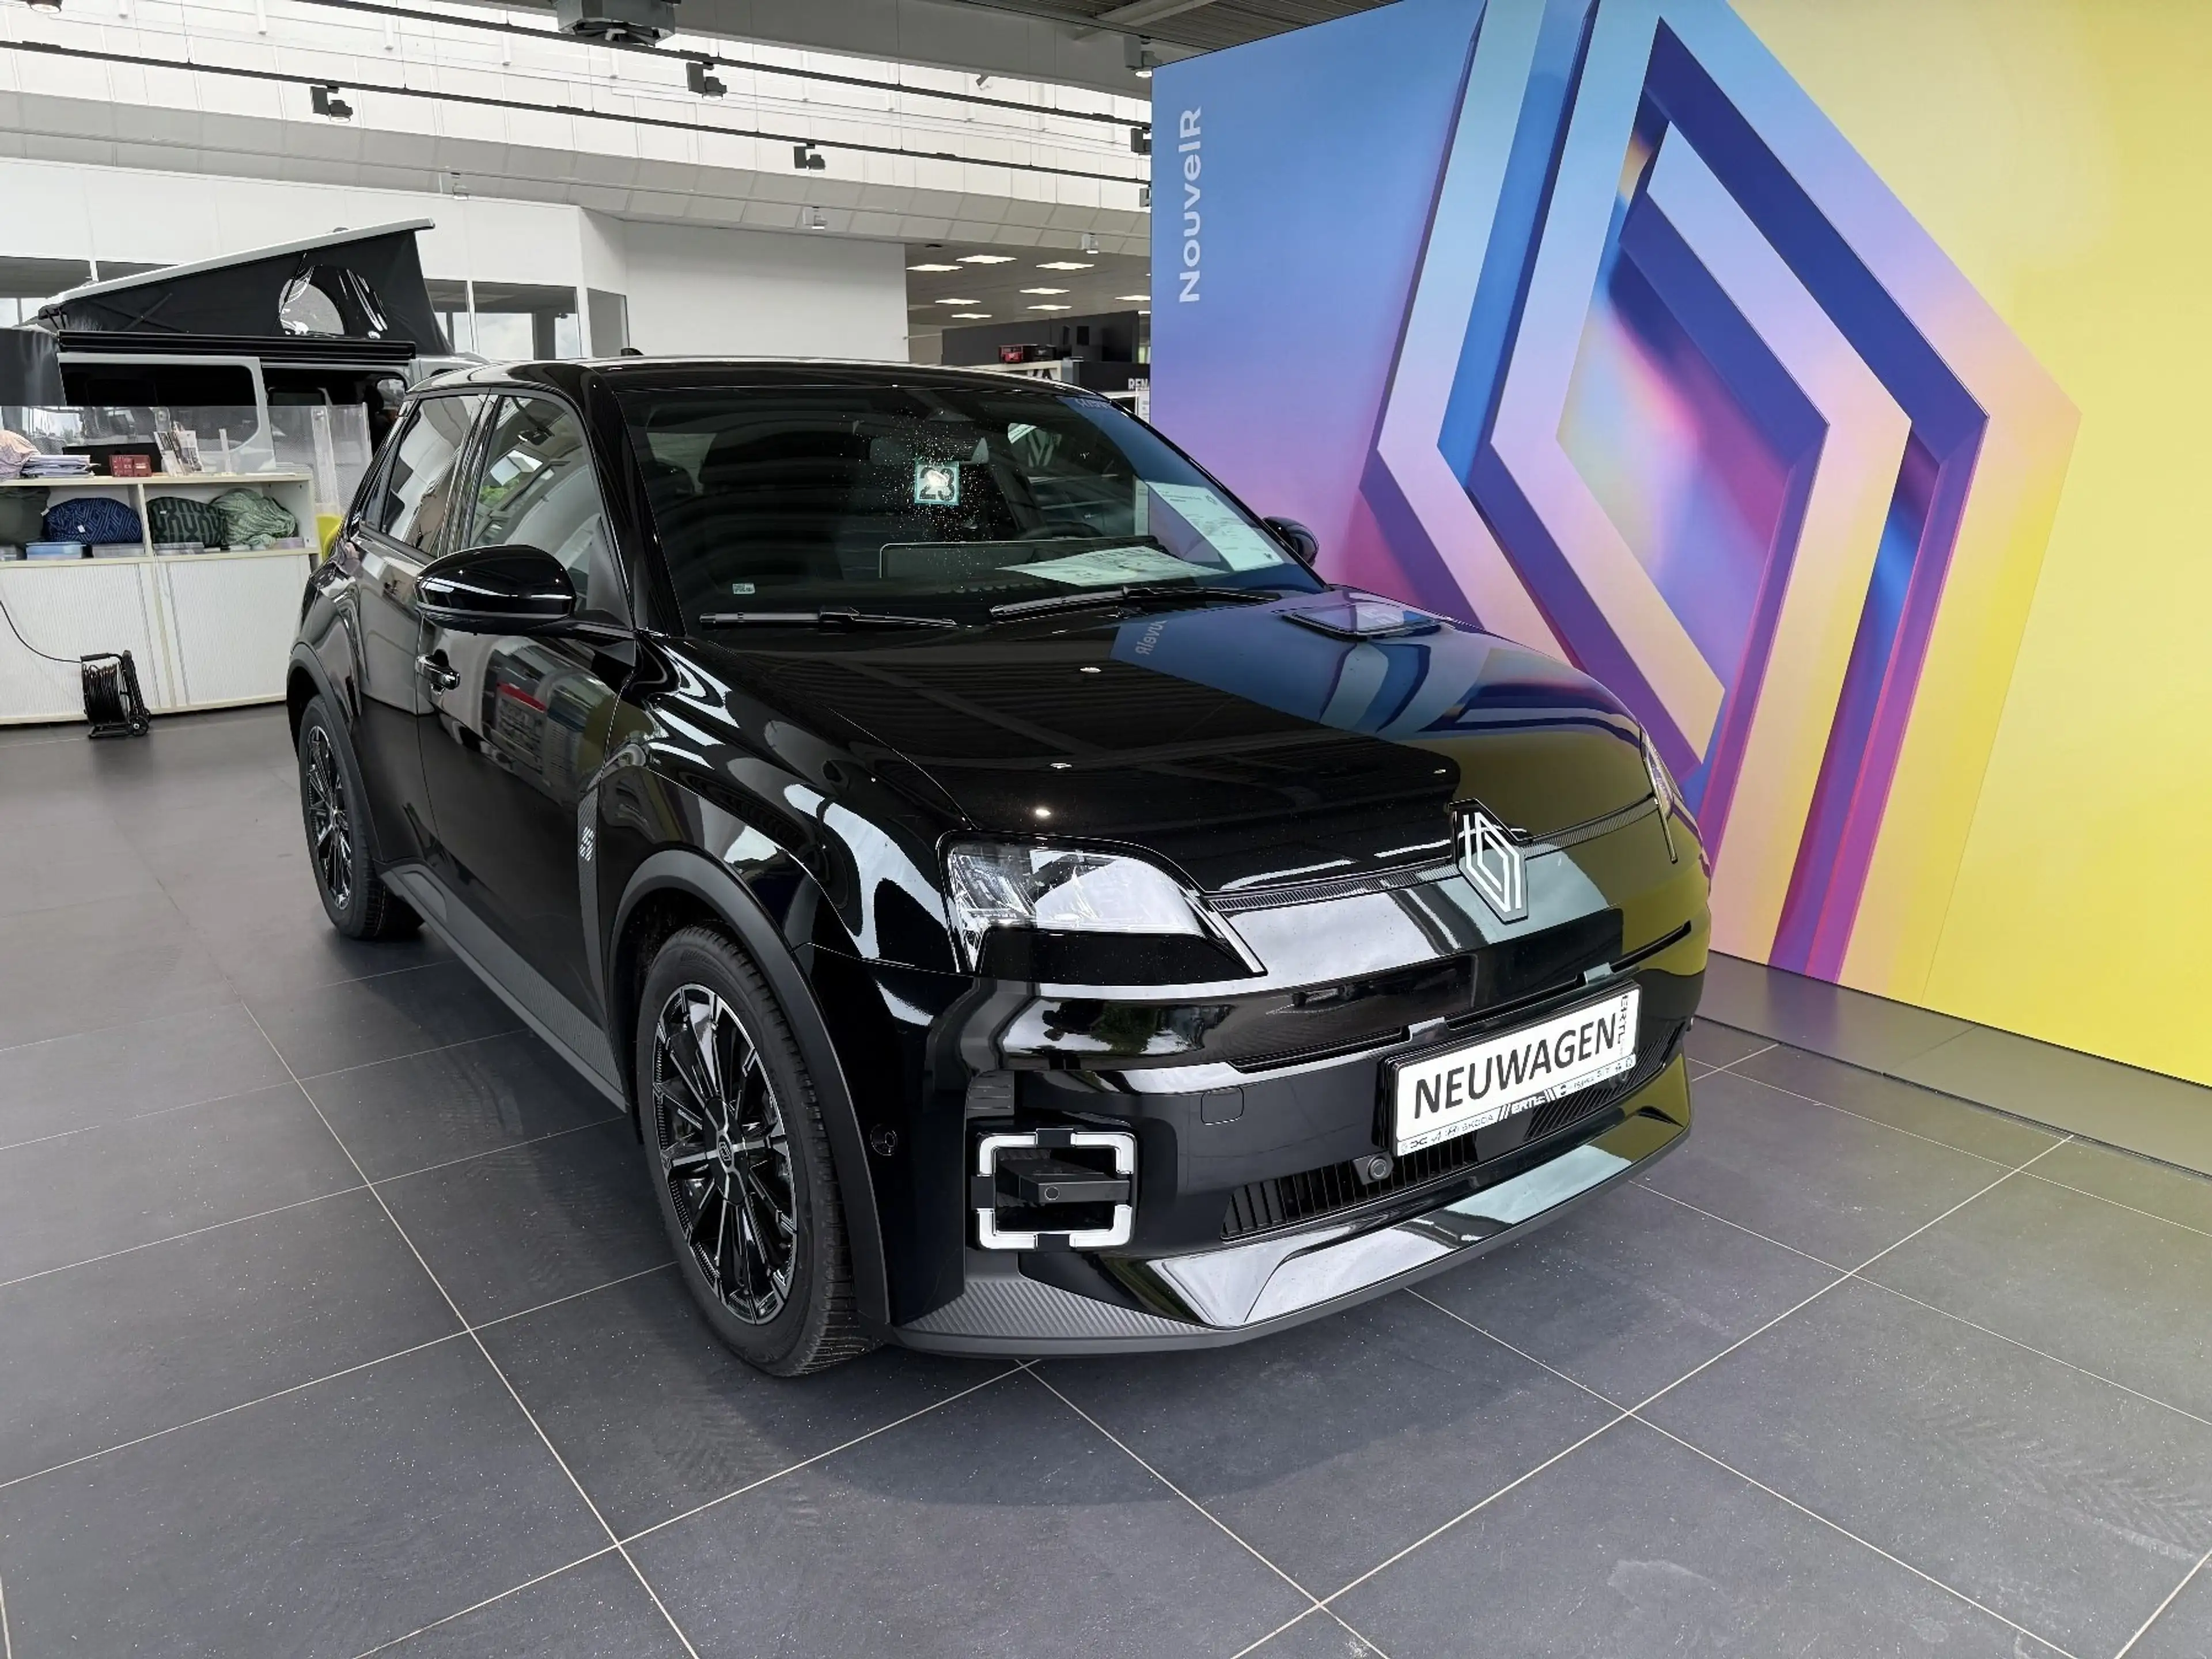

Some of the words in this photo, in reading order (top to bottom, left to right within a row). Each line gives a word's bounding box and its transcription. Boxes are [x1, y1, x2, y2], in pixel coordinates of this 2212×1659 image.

[1179, 106, 1202, 302] NouvelR
[1128, 378, 1149, 390] REN
[1415, 1013, 1616, 1119] NEUWAGEN
